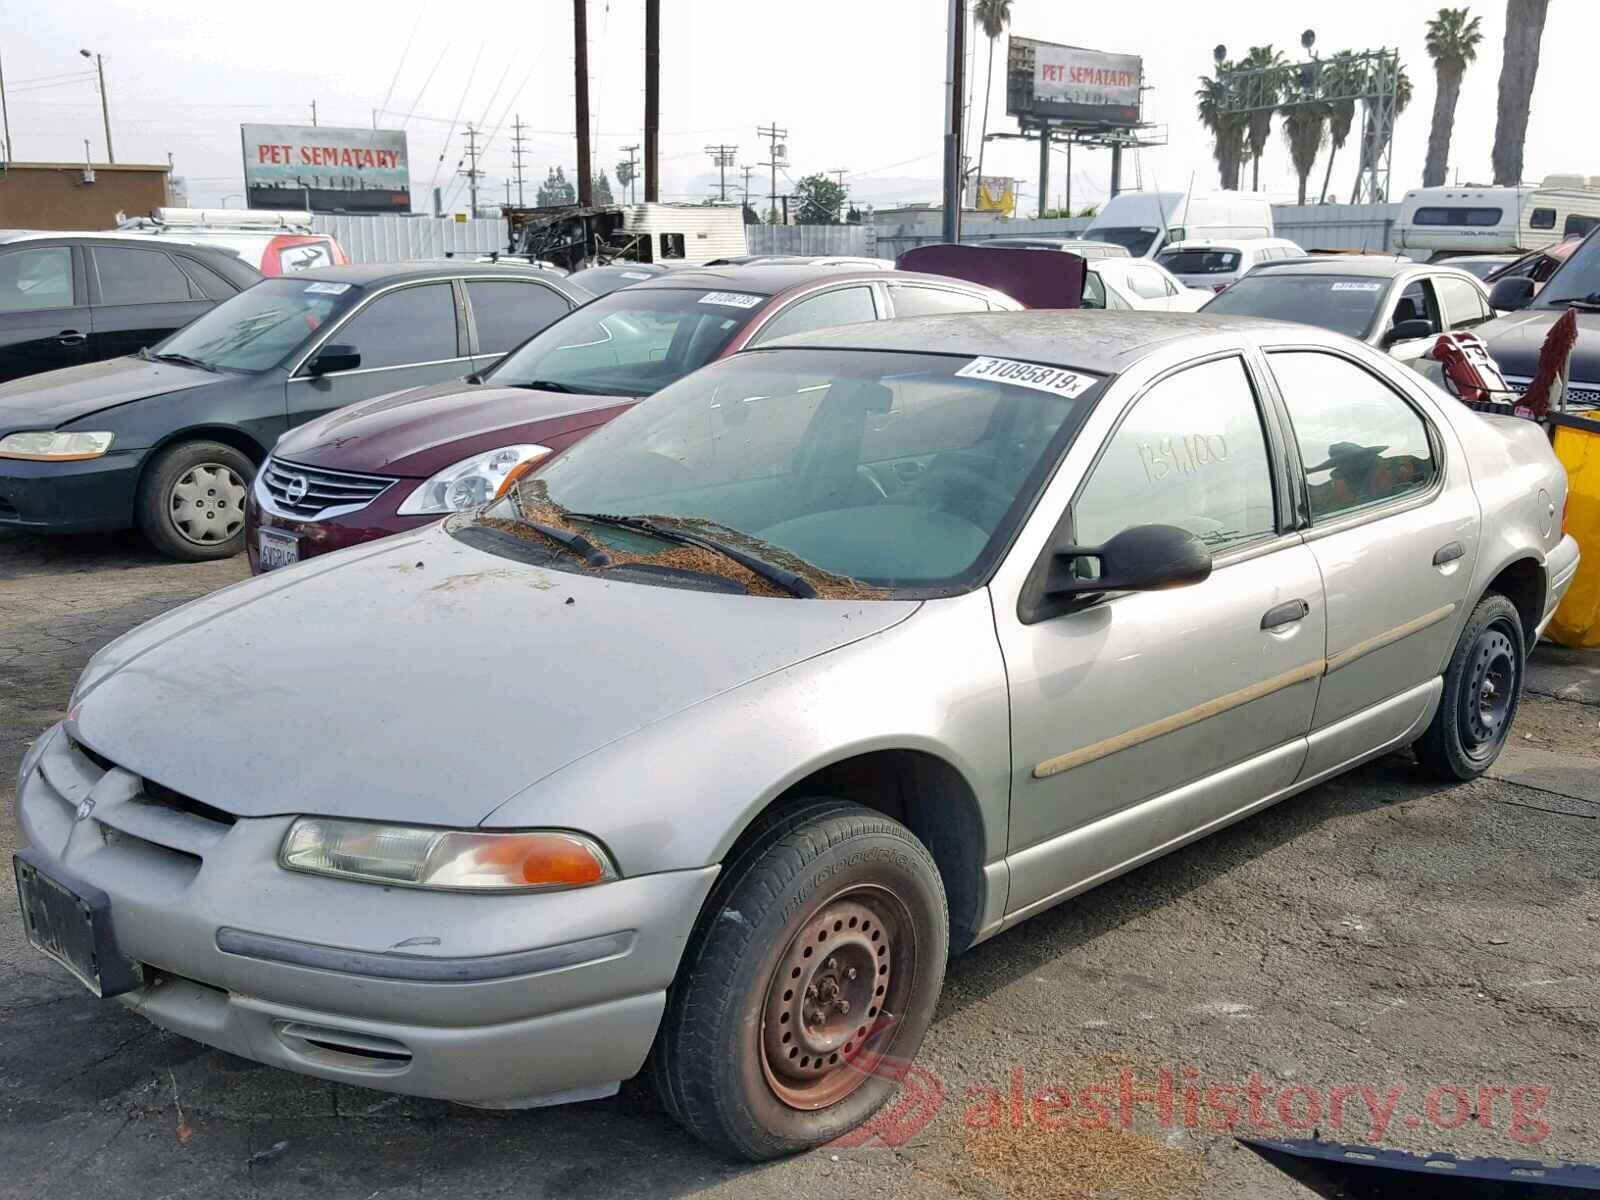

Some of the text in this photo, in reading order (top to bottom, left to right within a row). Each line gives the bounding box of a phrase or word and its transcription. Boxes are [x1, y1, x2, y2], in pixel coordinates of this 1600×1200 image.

[1042, 64, 1132, 87] PET SEMATARY
[258, 144, 400, 168] PET SEMATARY
